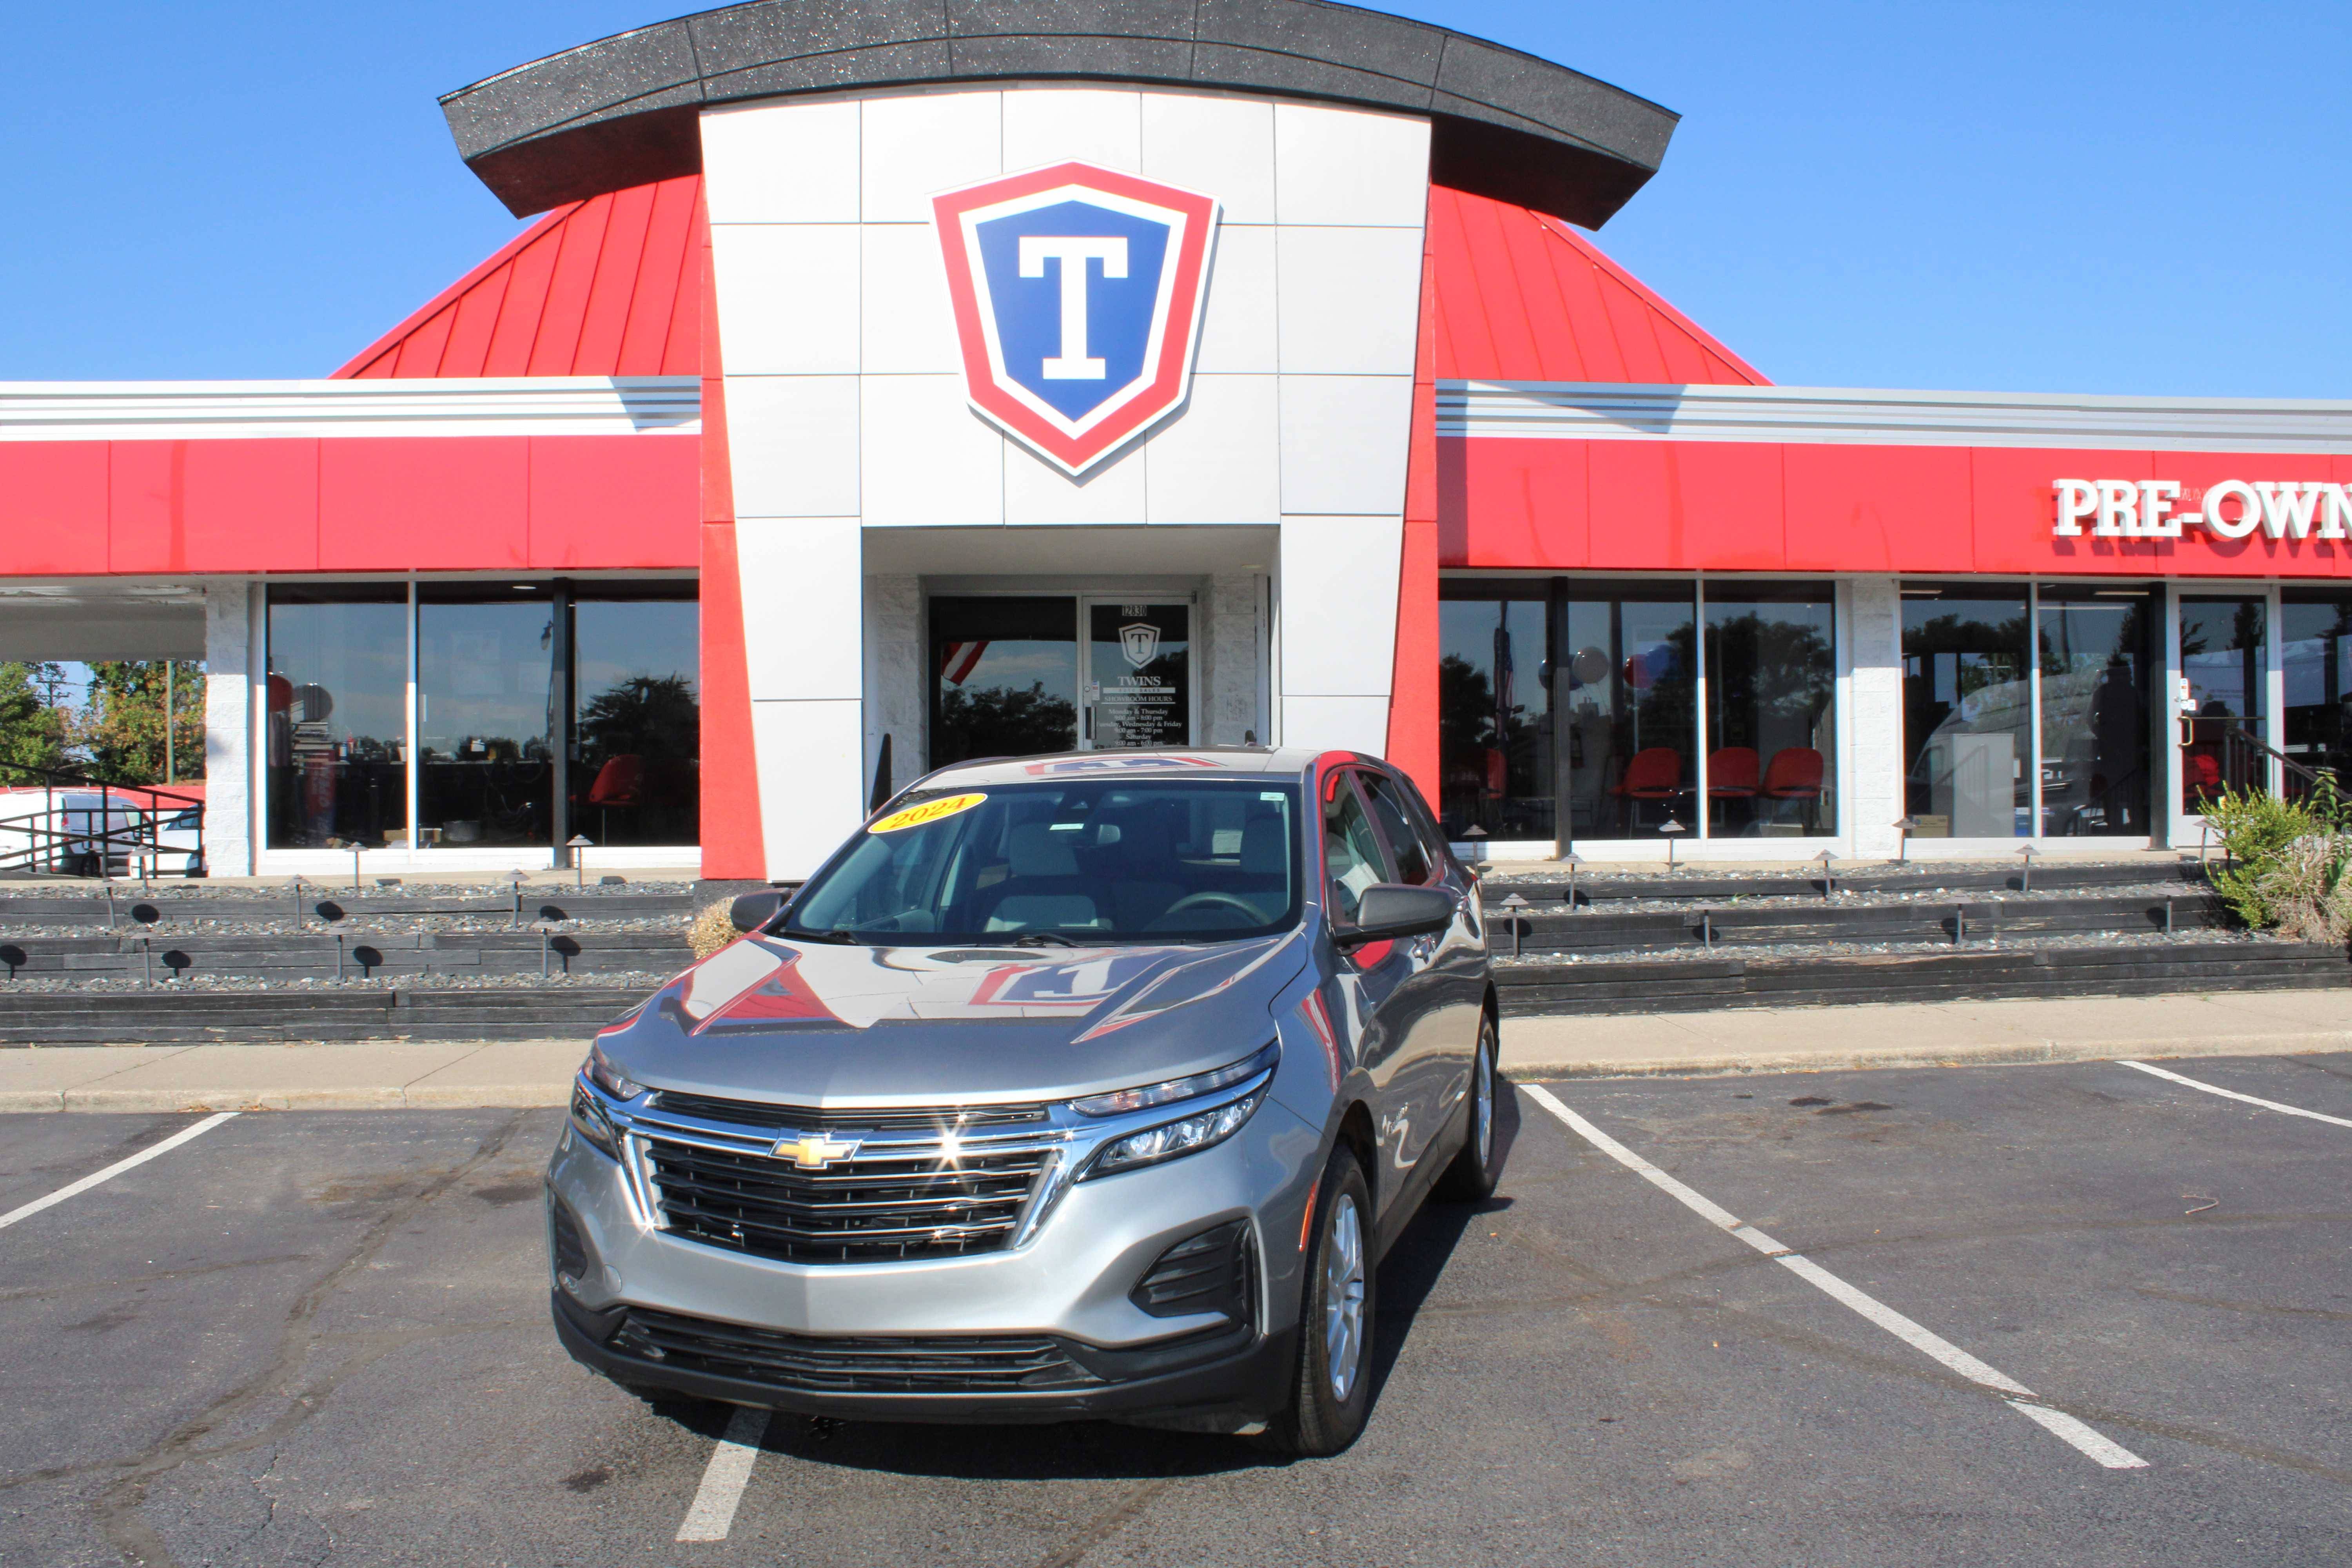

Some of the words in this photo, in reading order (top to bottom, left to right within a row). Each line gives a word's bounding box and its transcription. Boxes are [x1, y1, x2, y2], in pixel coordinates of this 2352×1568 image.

[1019, 237, 1128, 379] T
[2053, 479, 2352, 539] PRE-OWN
[1123, 606, 1147, 615] 12830
[1131, 633, 1148, 653] T
[1118, 676, 1161, 686] TWINS
[888, 797, 966, 829] 2024
